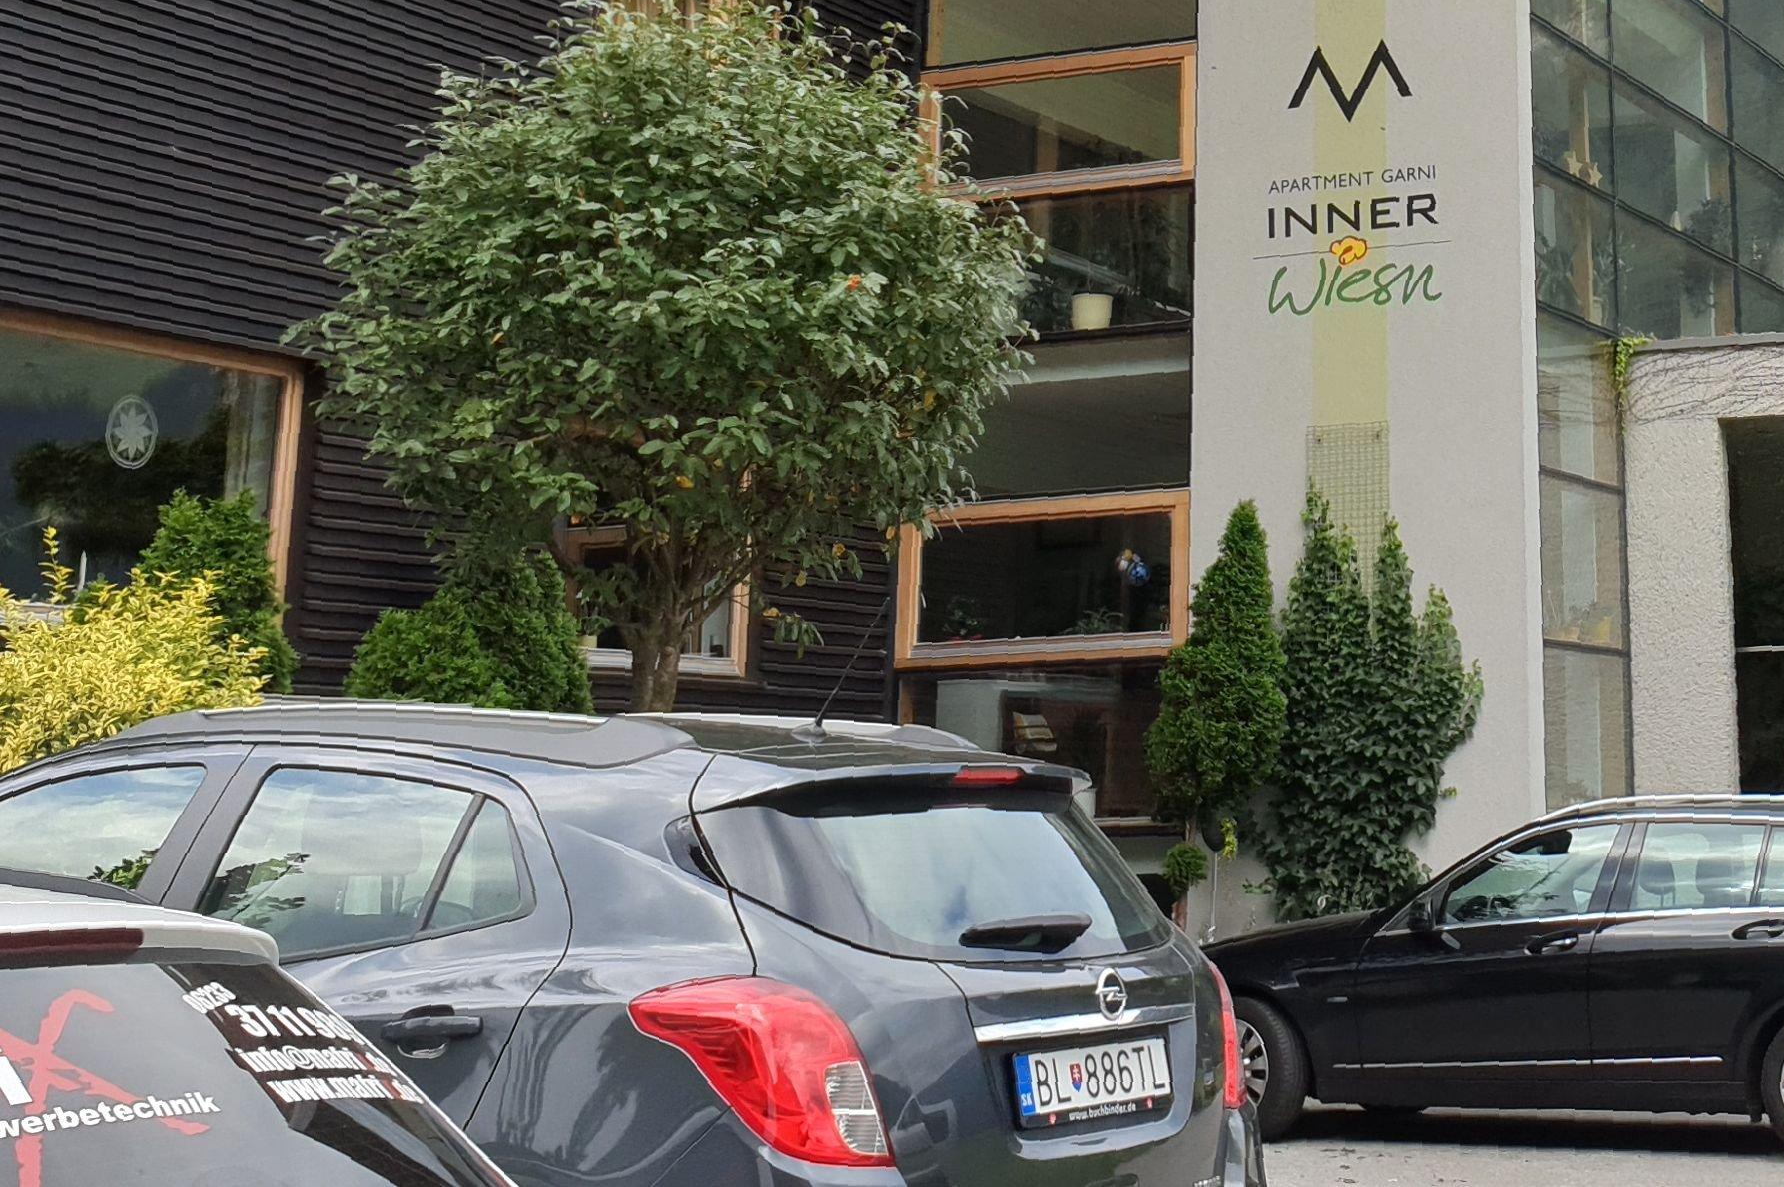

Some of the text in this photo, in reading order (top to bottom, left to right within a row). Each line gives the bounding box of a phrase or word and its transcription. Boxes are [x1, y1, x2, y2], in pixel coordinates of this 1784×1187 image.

[1269, 164, 1436, 195] APARTMENT GARNI
[1267, 193, 1439, 239] INNER
[1268, 257, 1443, 316] Wiesn
[1034, 1045, 1166, 1107] BL 886TL
[1021, 1092, 1033, 1107] SK
